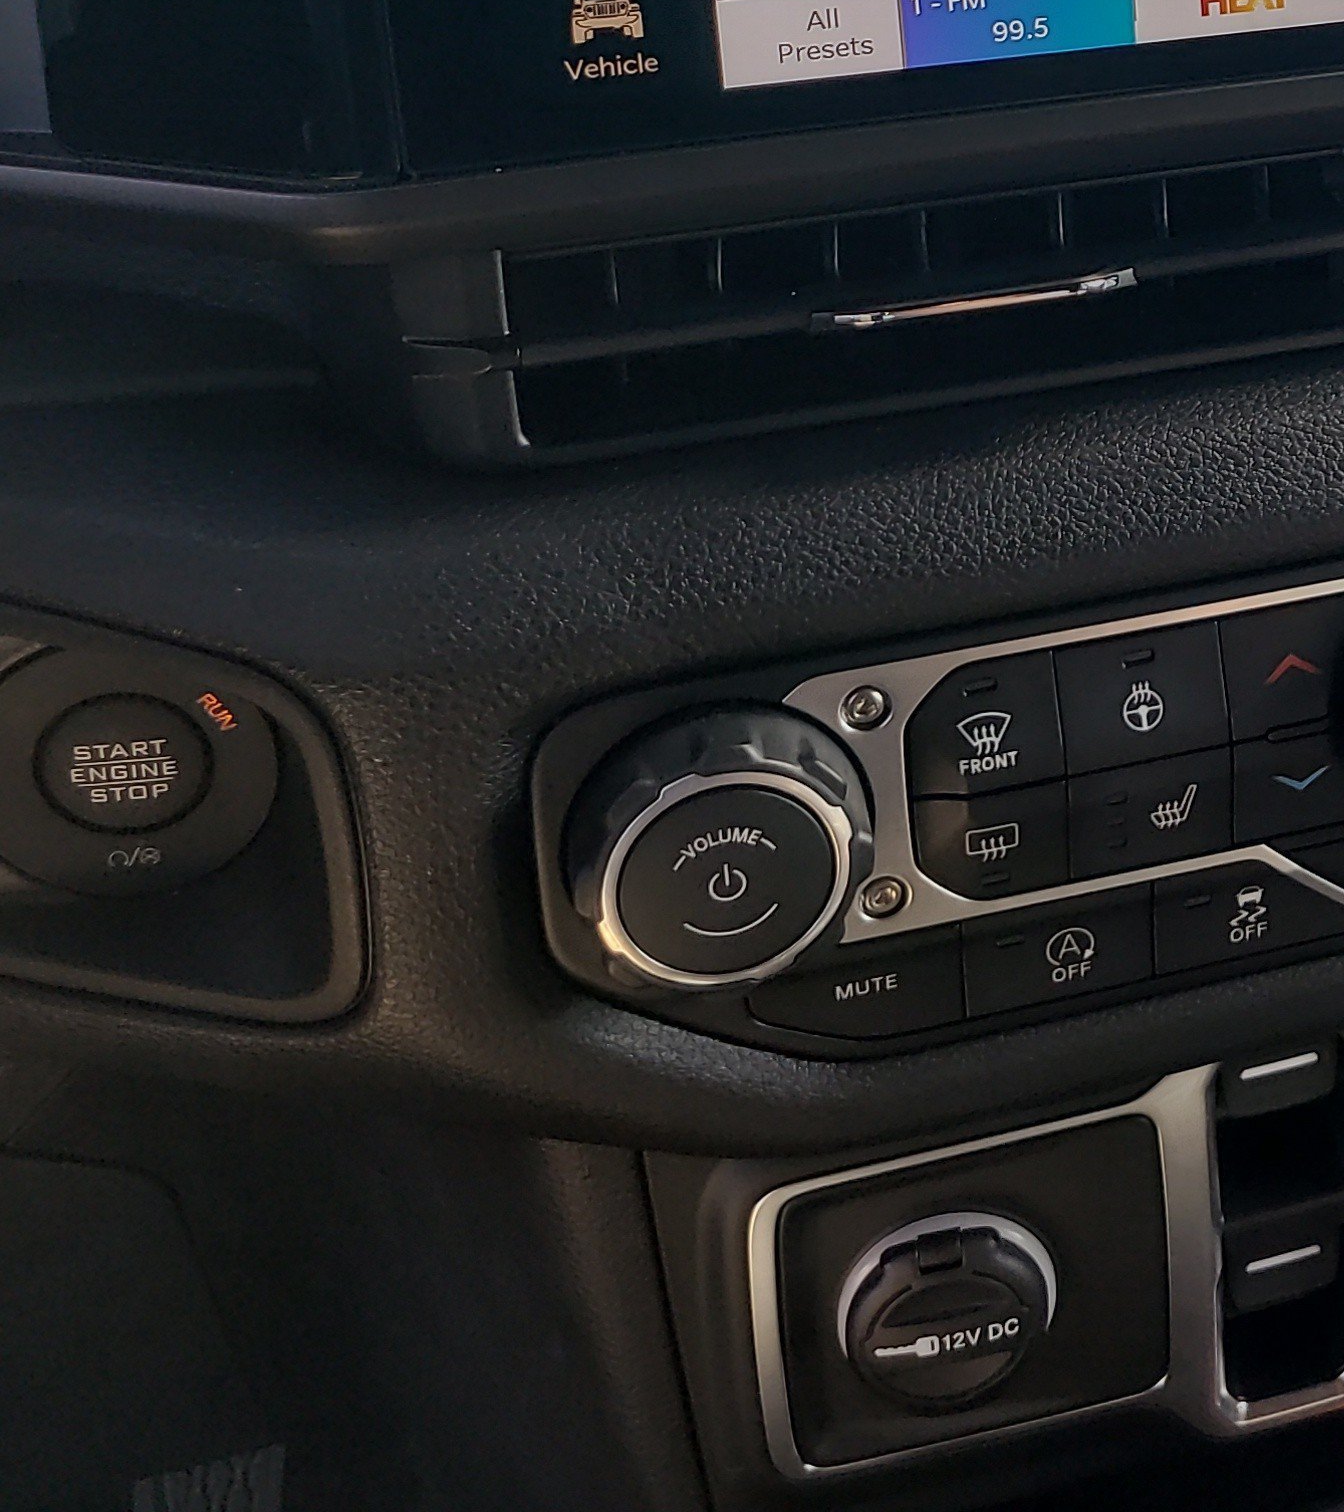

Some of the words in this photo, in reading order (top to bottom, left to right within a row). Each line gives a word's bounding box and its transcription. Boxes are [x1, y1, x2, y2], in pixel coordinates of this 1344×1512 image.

[805, 7, 840, 32] All
[991, 16, 1050, 43] 99.5
[777, 36, 875, 64] Presets
[563, 53, 660, 82] Vehicle
[195, 691, 240, 732] RUN
[72, 738, 169, 762] START
[957, 748, 1020, 775] FRONT
[70, 760, 180, 784] ENGINE
[89, 782, 170, 804] STOP
[682, 826, 764, 861] VOLUME
[1229, 920, 1269, 944] OFF
[1050, 959, 1092, 984] OFF
[834, 973, 899, 1003] MUTE
[941, 1324, 983, 1352] 12V
[987, 1317, 1021, 1341] DC
